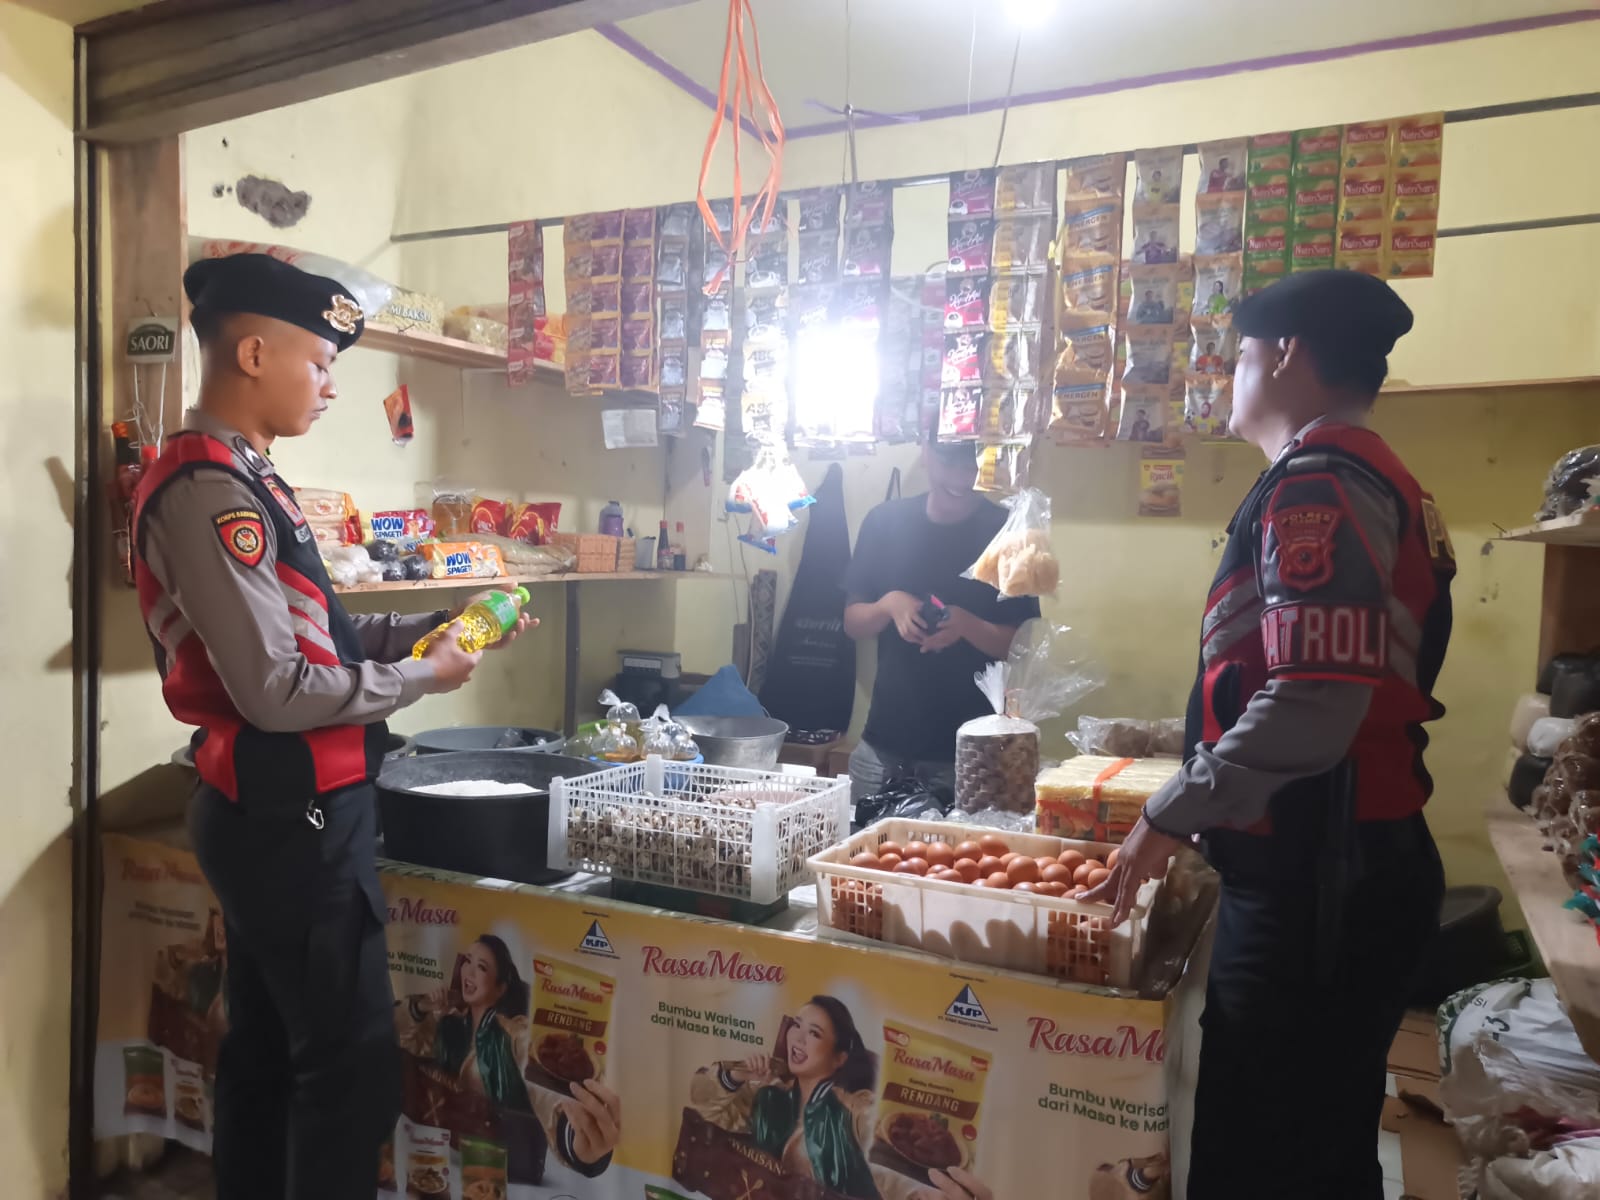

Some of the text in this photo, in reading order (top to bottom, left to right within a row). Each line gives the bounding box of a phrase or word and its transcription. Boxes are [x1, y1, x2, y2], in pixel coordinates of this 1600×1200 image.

[131, 335, 169, 351] SAORI
[371, 517, 404, 531] WOW
[446, 552, 471, 567] WOW
[397, 952, 437, 967] Warisan
[416, 966, 445, 980] Masa
[658, 1001, 756, 1031] Bumbu Warisan
[651, 1013, 764, 1046] dari Masa ke Masa
[900, 1087, 960, 1112] RENDANG
[1049, 1082, 1106, 1107] Bumbu
[1038, 1096, 1069, 1113] dari
[1073, 1103, 1116, 1126] Masa
[1120, 1114, 1139, 1132] ke
